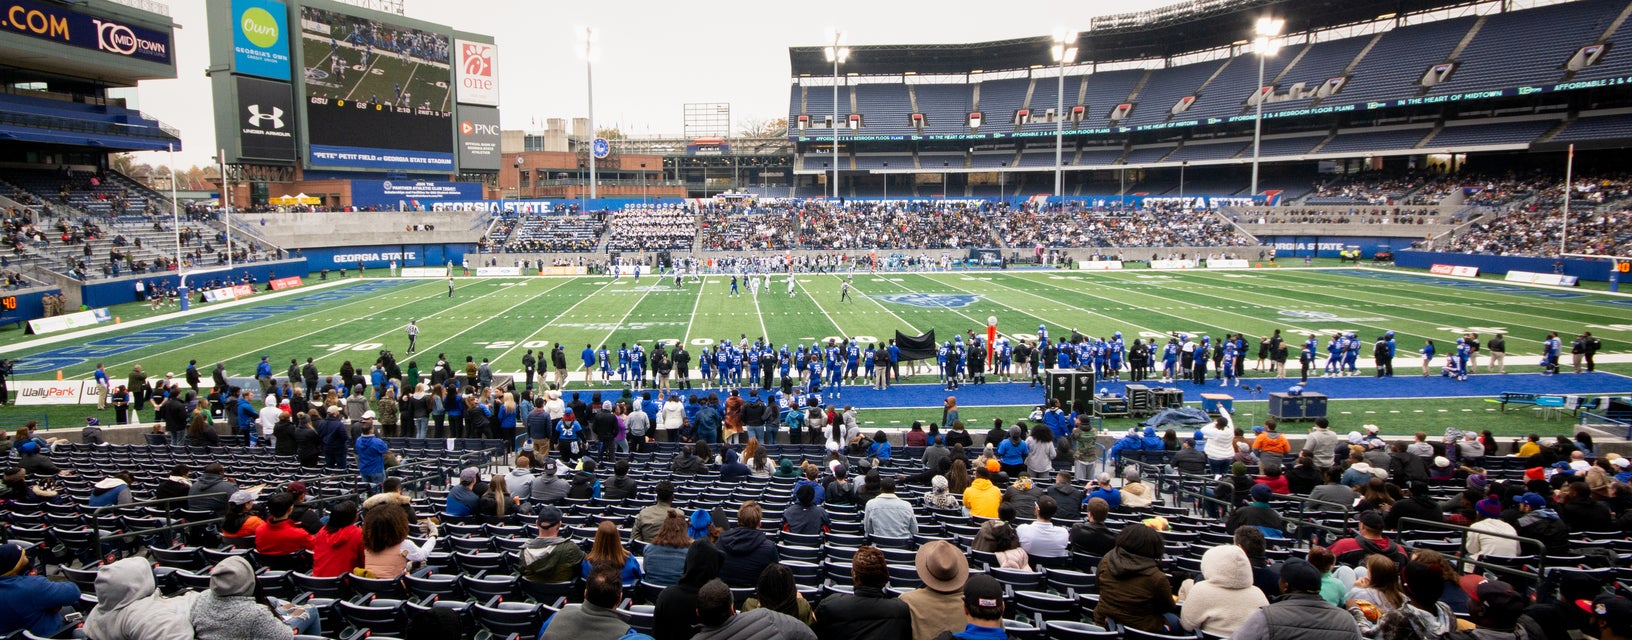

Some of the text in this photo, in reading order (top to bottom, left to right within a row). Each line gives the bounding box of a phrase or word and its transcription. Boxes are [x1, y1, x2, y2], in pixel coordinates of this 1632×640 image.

[243, 18, 276, 37] Own
[235, 46, 288, 61] GEORGIA'S OWN
[463, 77, 492, 90] one
[1553, 78, 1607, 91] AFFORDABLE
[1608, 78, 1615, 86] 2
[1616, 77, 1624, 85] &
[1408, 97, 1422, 105] THE
[1424, 95, 1448, 103] HEART
[1464, 90, 1503, 99] MIDTOWN
[311, 97, 328, 106] GSU
[338, 100, 345, 108] 0
[356, 101, 368, 110] GS
[376, 104, 382, 112] 0
[1280, 109, 1310, 118] BEDROOM
[1311, 106, 1333, 114] FLOOR
[1334, 104, 1355, 112] PLANS
[474, 123, 499, 136] PNC
[428, 157, 452, 165] STADIUM
[433, 201, 551, 214] GEORGIA STATE
[333, 251, 416, 263] GEORGIA STATE
[2, 296, 16, 309] 40
[22, 387, 76, 398] WallyPark
[562, 427, 573, 436] 75
